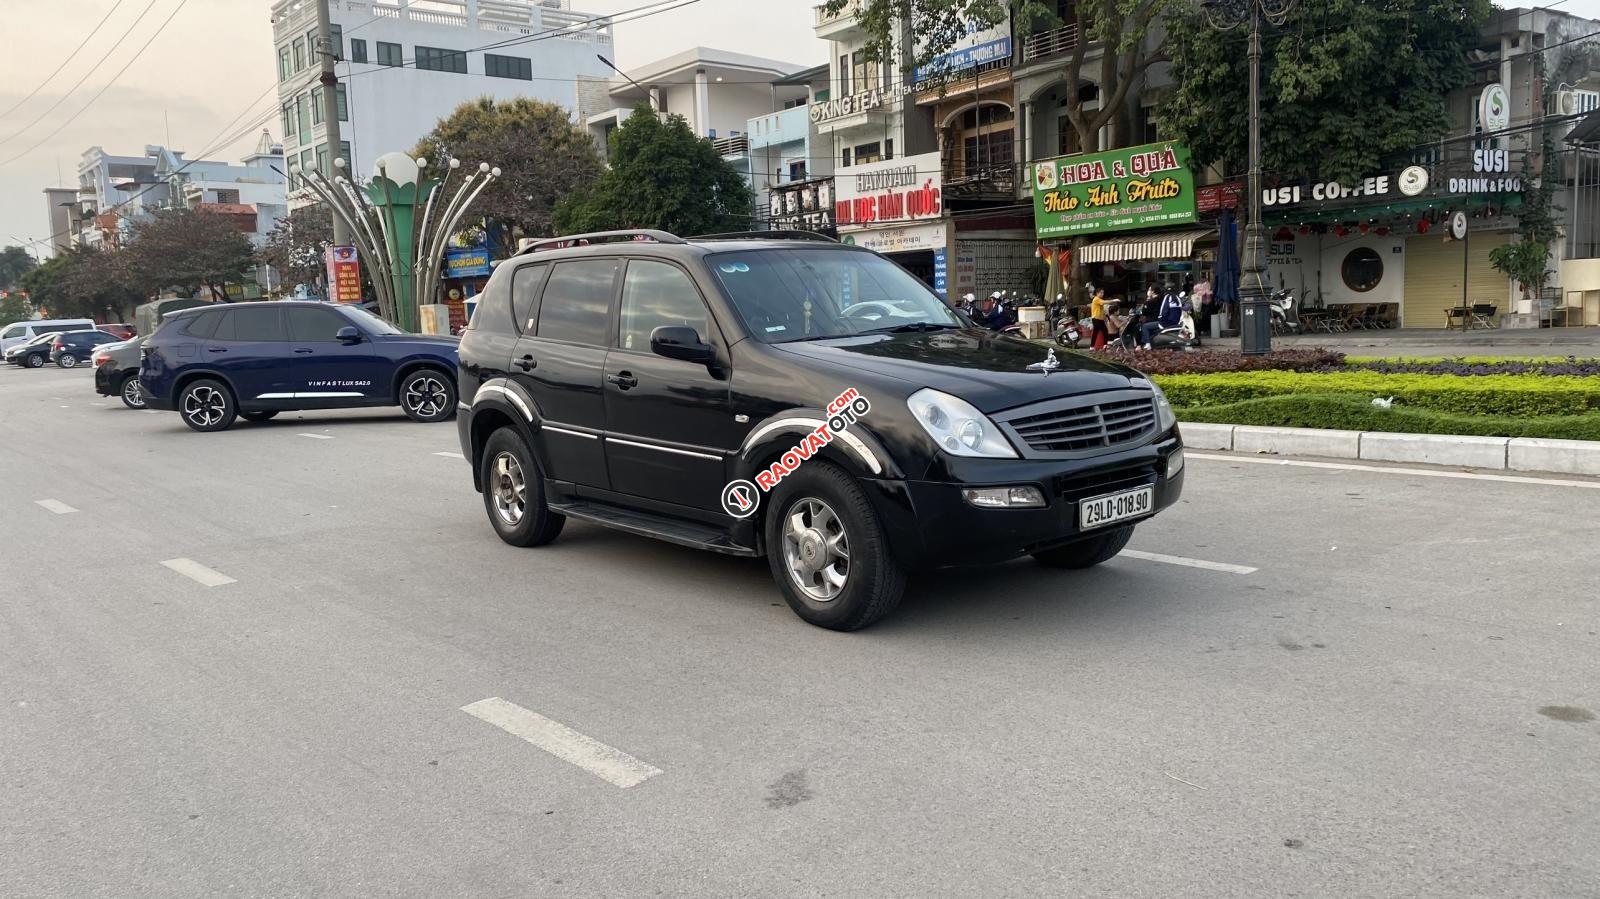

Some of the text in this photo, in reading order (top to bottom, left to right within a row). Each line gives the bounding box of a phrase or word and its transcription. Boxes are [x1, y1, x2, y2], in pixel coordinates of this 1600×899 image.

[822, 89, 879, 120] KING TEA
[1060, 160, 1109, 186] HOA
[1113, 160, 1128, 179] &
[1473, 149, 1509, 172] SUSI
[856, 164, 917, 193] HANNAM
[1449, 178, 1488, 193] DRINK
[1498, 178, 1526, 192] FOO
[853, 196, 876, 228] HỌC
[878, 188, 904, 221] HÀN
[906, 178, 940, 220] QUỐC
[1084, 183, 1120, 208] Anh
[1263, 186, 1300, 206] USI
[803, 212, 831, 230] TEA
[1086, 491, 1148, 524] 29LD-018.90
